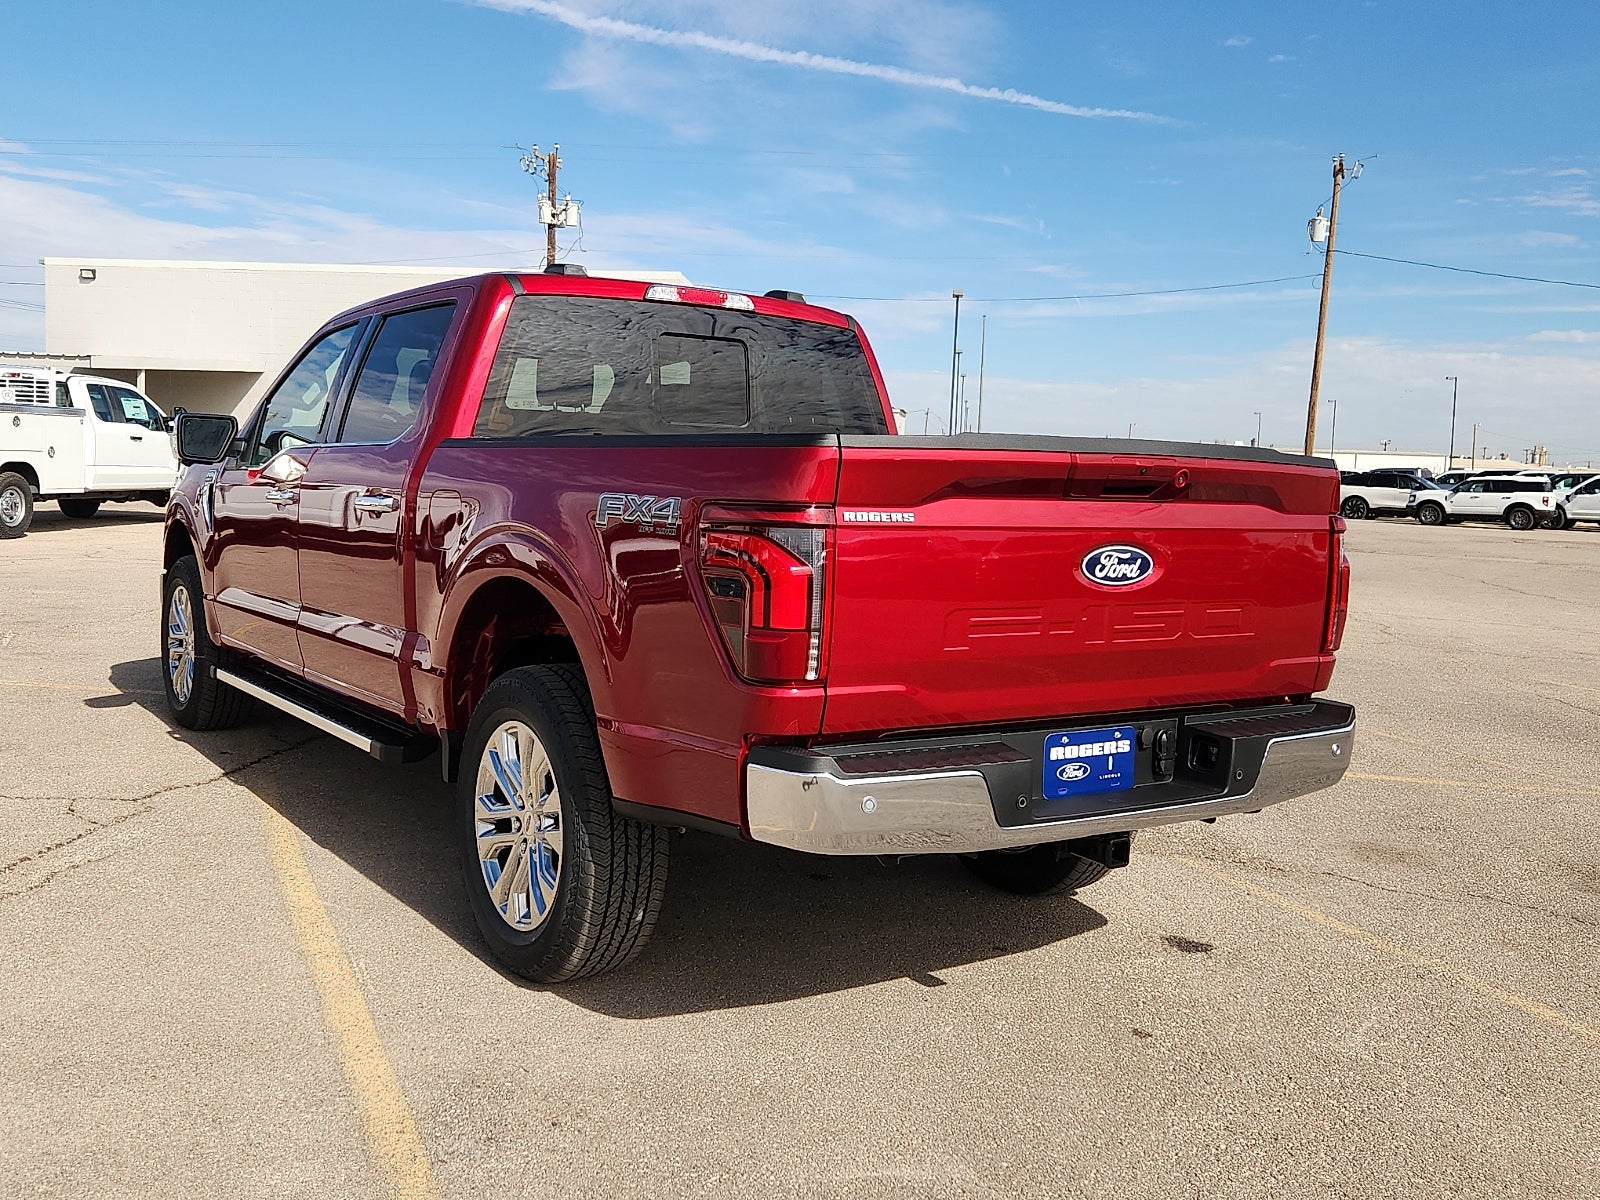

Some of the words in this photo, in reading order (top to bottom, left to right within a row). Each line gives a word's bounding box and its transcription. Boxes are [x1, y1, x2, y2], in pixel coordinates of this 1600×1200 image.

[595, 492, 681, 528] FX4
[843, 511, 915, 523] ROGERS
[1093, 551, 1142, 579] Ford
[943, 601, 1257, 651] F-150
[1049, 739, 1131, 761] ROGERS
